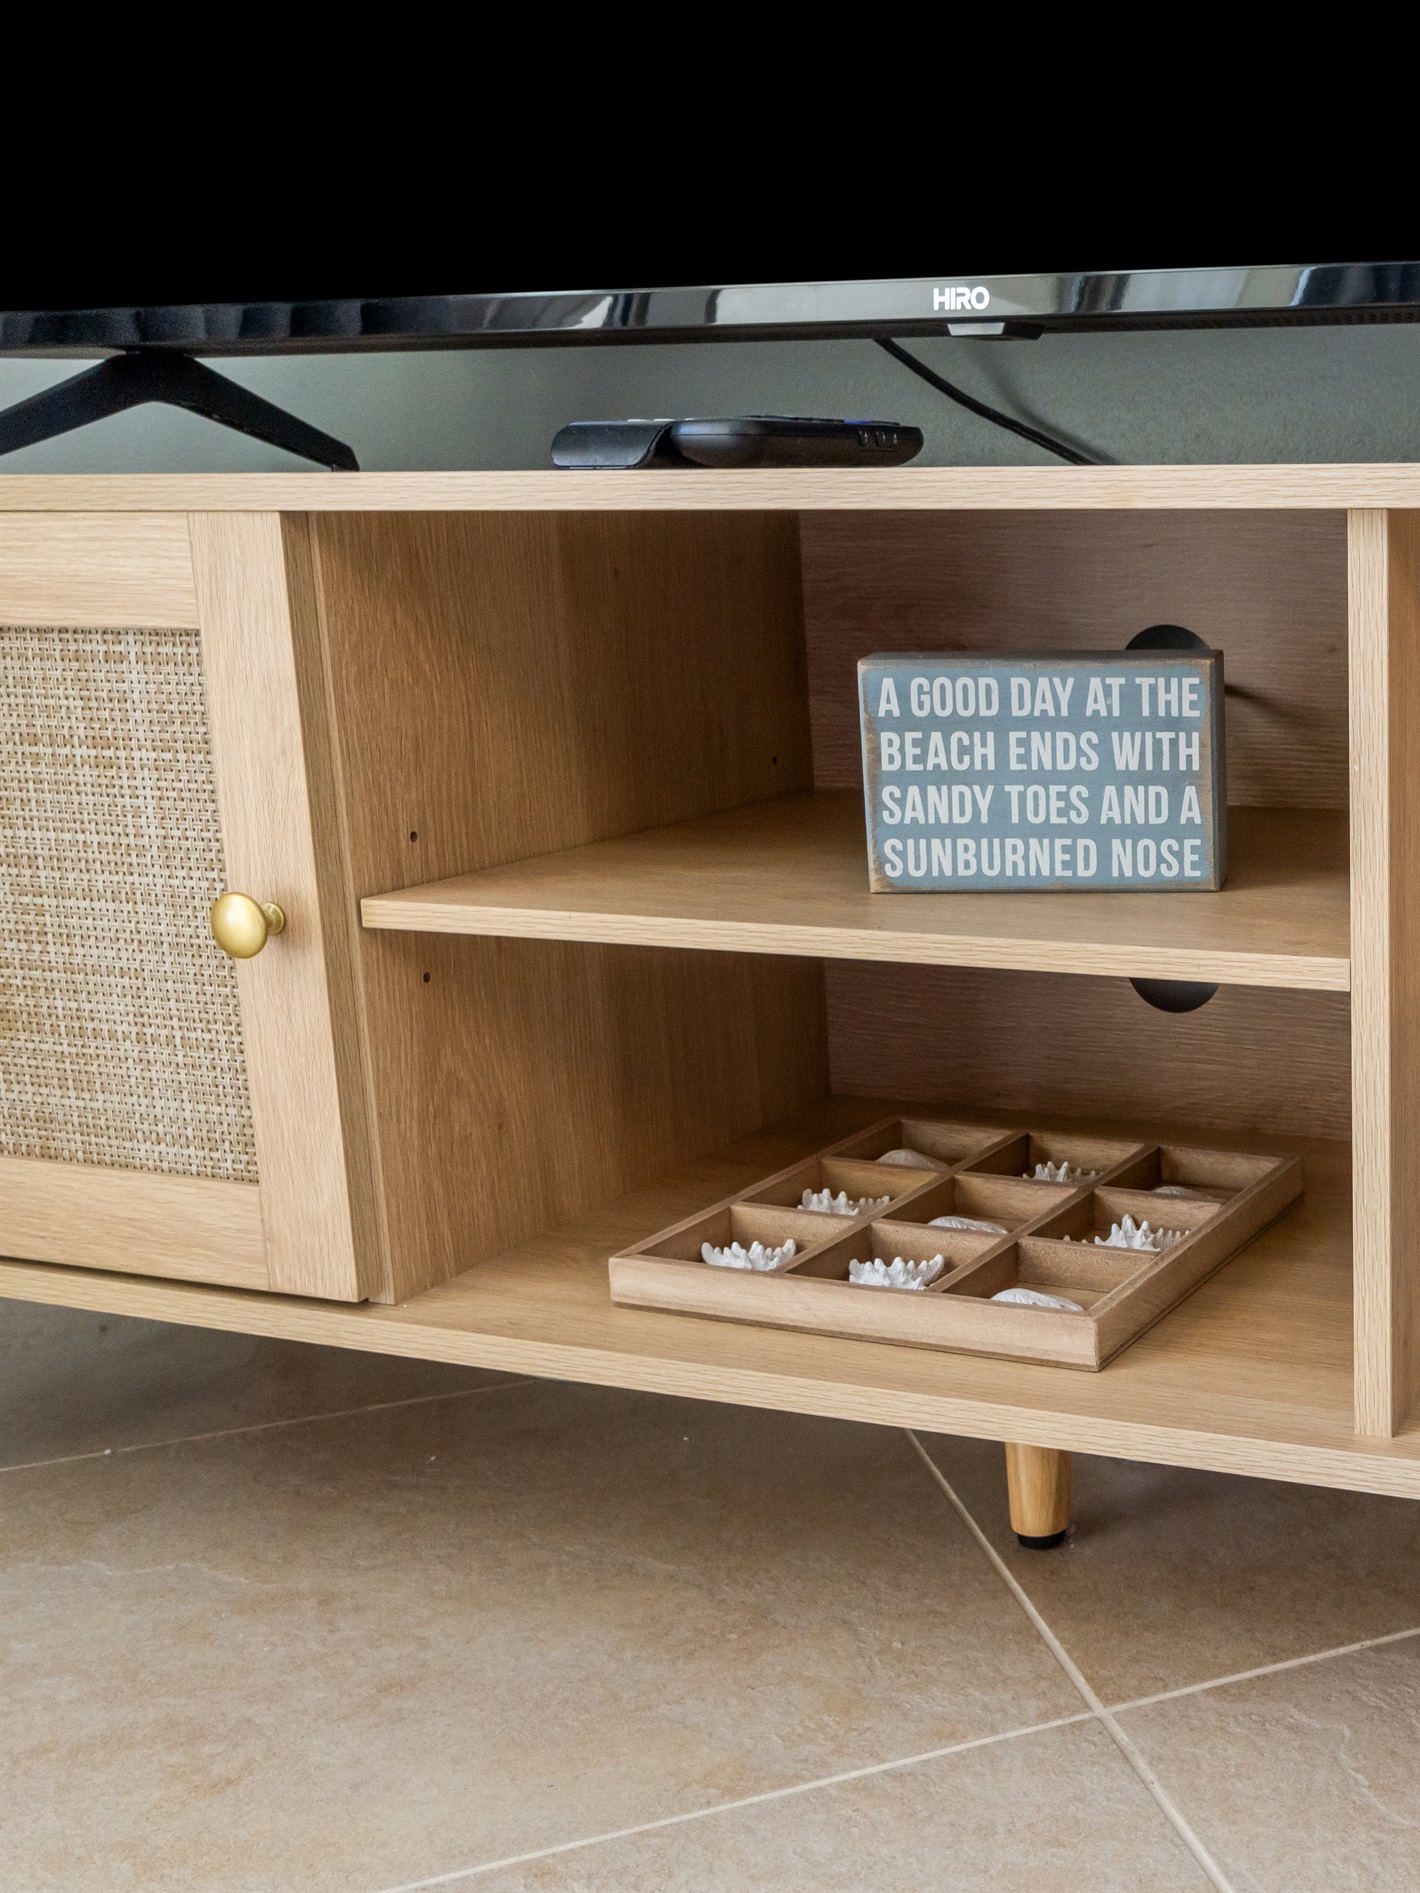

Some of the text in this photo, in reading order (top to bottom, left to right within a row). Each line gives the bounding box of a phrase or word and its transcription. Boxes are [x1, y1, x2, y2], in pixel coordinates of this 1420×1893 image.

[933, 286, 990, 310] HIRO
[878, 677, 1201, 718] A GOOD DAY AT THE
[880, 731, 1200, 772] BEACH ENDS WITH
[881, 785, 1202, 825] SANDY TOES AND A
[884, 838, 1201, 878] SUNBURNED NOSE
